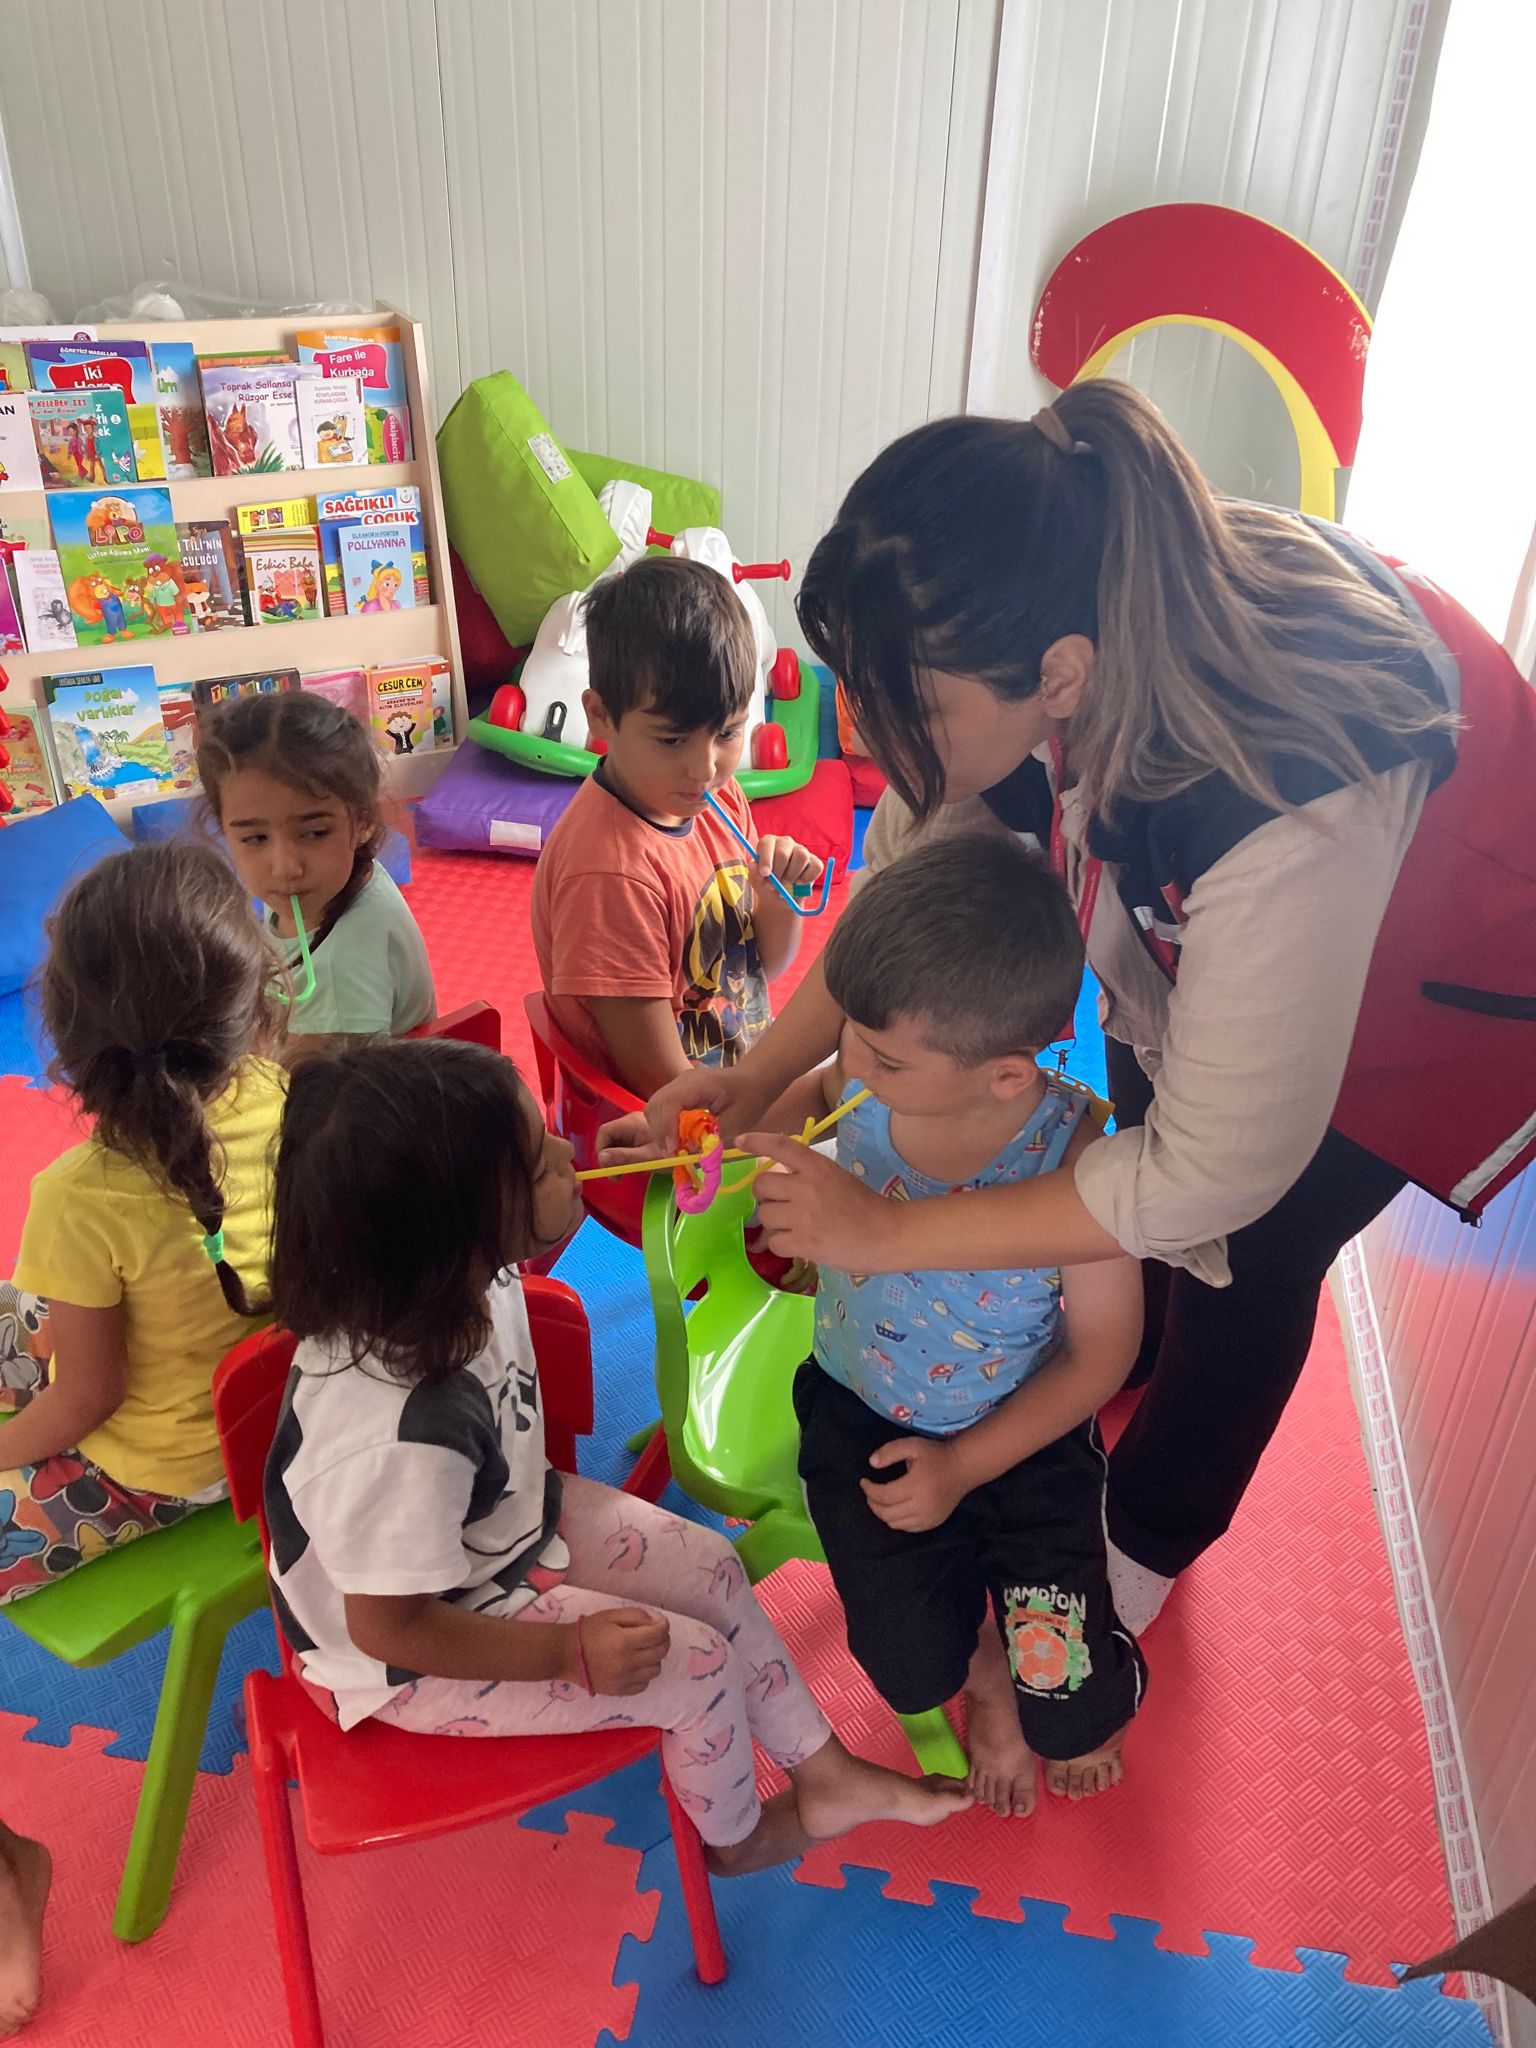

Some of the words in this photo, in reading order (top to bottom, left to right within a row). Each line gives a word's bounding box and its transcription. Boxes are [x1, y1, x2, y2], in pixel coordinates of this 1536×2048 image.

[329, 353, 352, 364] Fare
[354, 350, 366, 360] ile
[83, 364, 103, 381] İki
[330, 367, 374, 378] Kurbağa
[221, 382, 252, 393] Toprak
[256, 380, 292, 390] Sallansa
[238, 393, 269, 403] Rüzgar
[273, 391, 293, 400] Esse
[325, 496, 394, 514] SAĞLIKLI
[347, 537, 406, 551] POLLYANNA
[180, 552, 218, 567] CULUĞU
[256, 559, 287, 571] Eskici
[378, 679, 404, 692] CESUR
[406, 677, 423, 688] CEM
